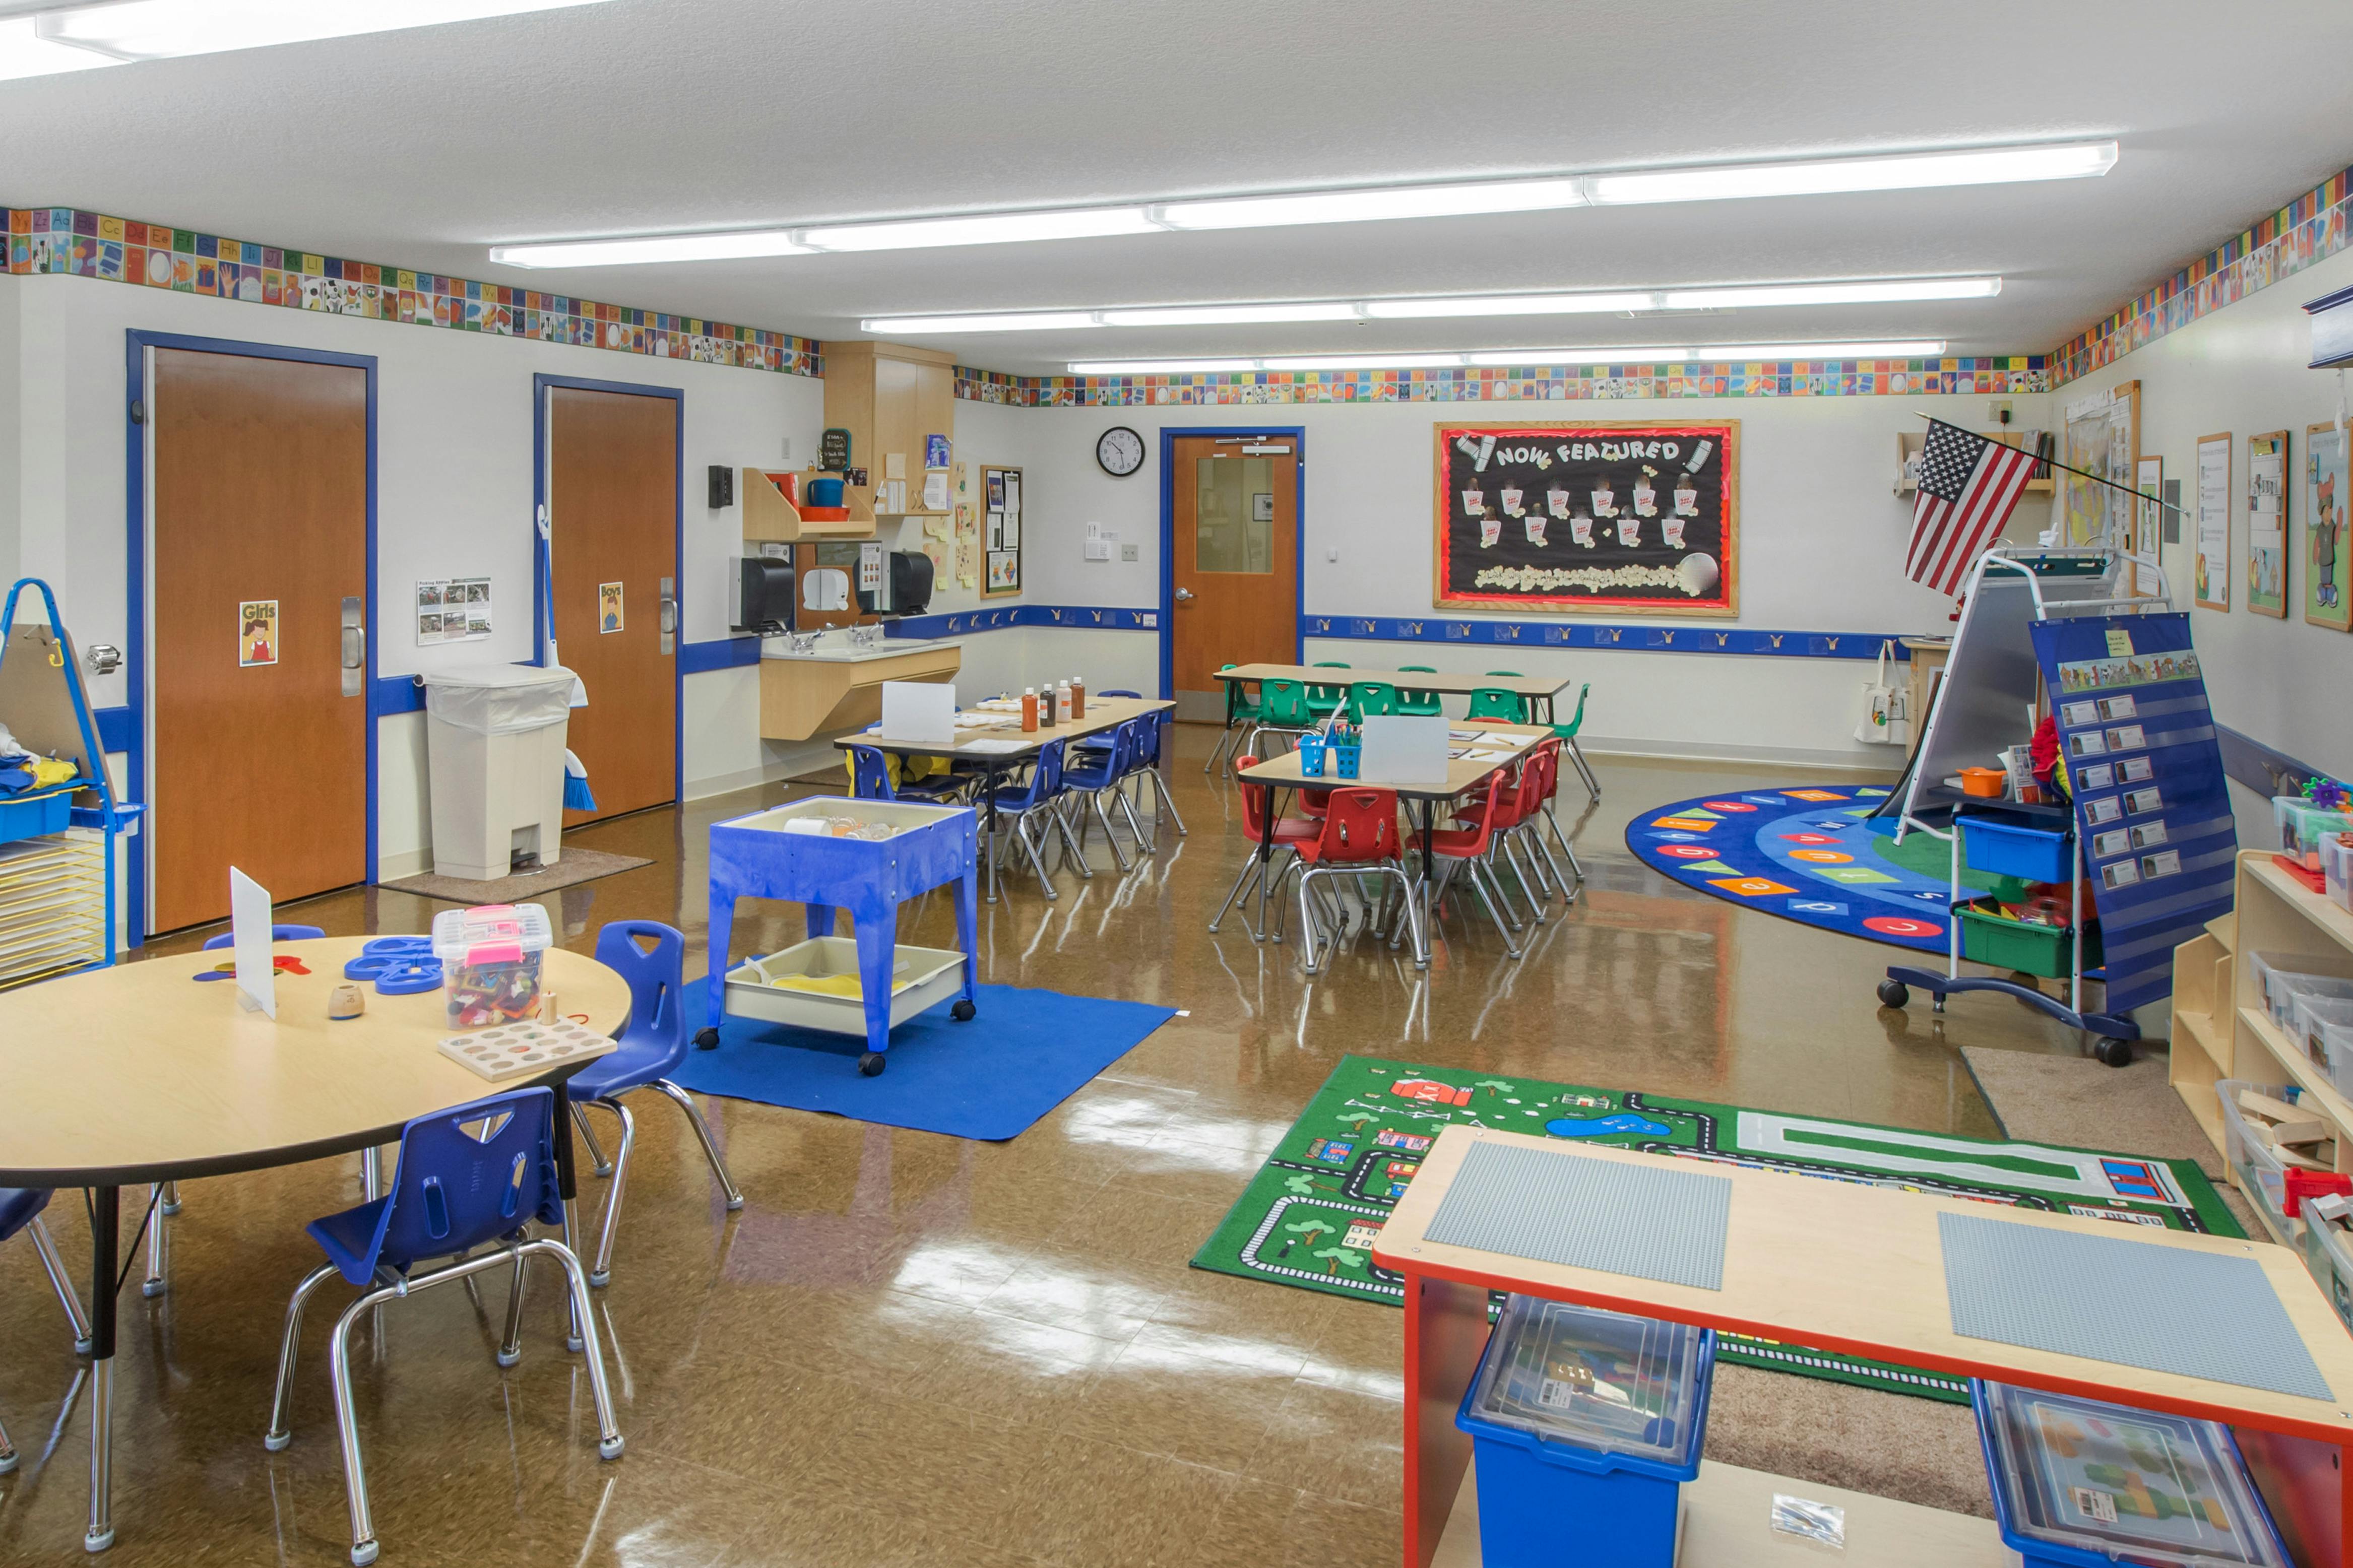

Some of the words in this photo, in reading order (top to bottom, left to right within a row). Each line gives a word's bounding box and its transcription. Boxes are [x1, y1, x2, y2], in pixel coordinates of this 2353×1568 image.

[35, 212, 48, 227] Zz
[52, 211, 70, 226] Aa
[77, 213, 95, 230] Bb
[102, 220, 120, 235] Cc
[126, 225, 144, 239] Dd
[152, 229, 169, 244] Ee
[177, 232, 192, 247] Ff
[222, 242, 238, 256] Hh
[248, 246, 256, 260] Ii
[266, 250, 280, 267] Jj
[286, 251, 301, 267] Kk
[307, 257, 319, 270] Ll
[345, 263, 359, 276] Nn
[363, 267, 378, 280] Oo
[382, 270, 396, 283] Pp
[399, 272, 415, 290] Qq
[418, 275, 429, 287] Rr
[435, 278, 447, 291] Ss
[453, 281, 464, 292] Tt
[468, 284, 480, 296] Uu
[483, 286, 495, 297] Vv
[555, 298, 567, 310] Aa
[583, 303, 593, 314] Cc
[1439, 370, 1452, 379] Aa
[1669, 365, 1682, 376] Qq
[1685, 365, 1696, 374] Rr
[1748, 364, 1759, 372] Vv
[1797, 363, 1808, 373] Yy
[1827, 363, 1840, 371] Aa
[1962, 360, 1970, 368] Ii
[1977, 360, 1989, 370] Jj
[1496, 446, 1550, 467] NOW
[1556, 440, 1680, 463] FEATURED
[601, 586, 621, 598] Boys
[243, 604, 276, 619] Girls
[1676, 848, 1714, 856] g
[1793, 902, 1836, 911] d
[1887, 922, 1918, 931] c
